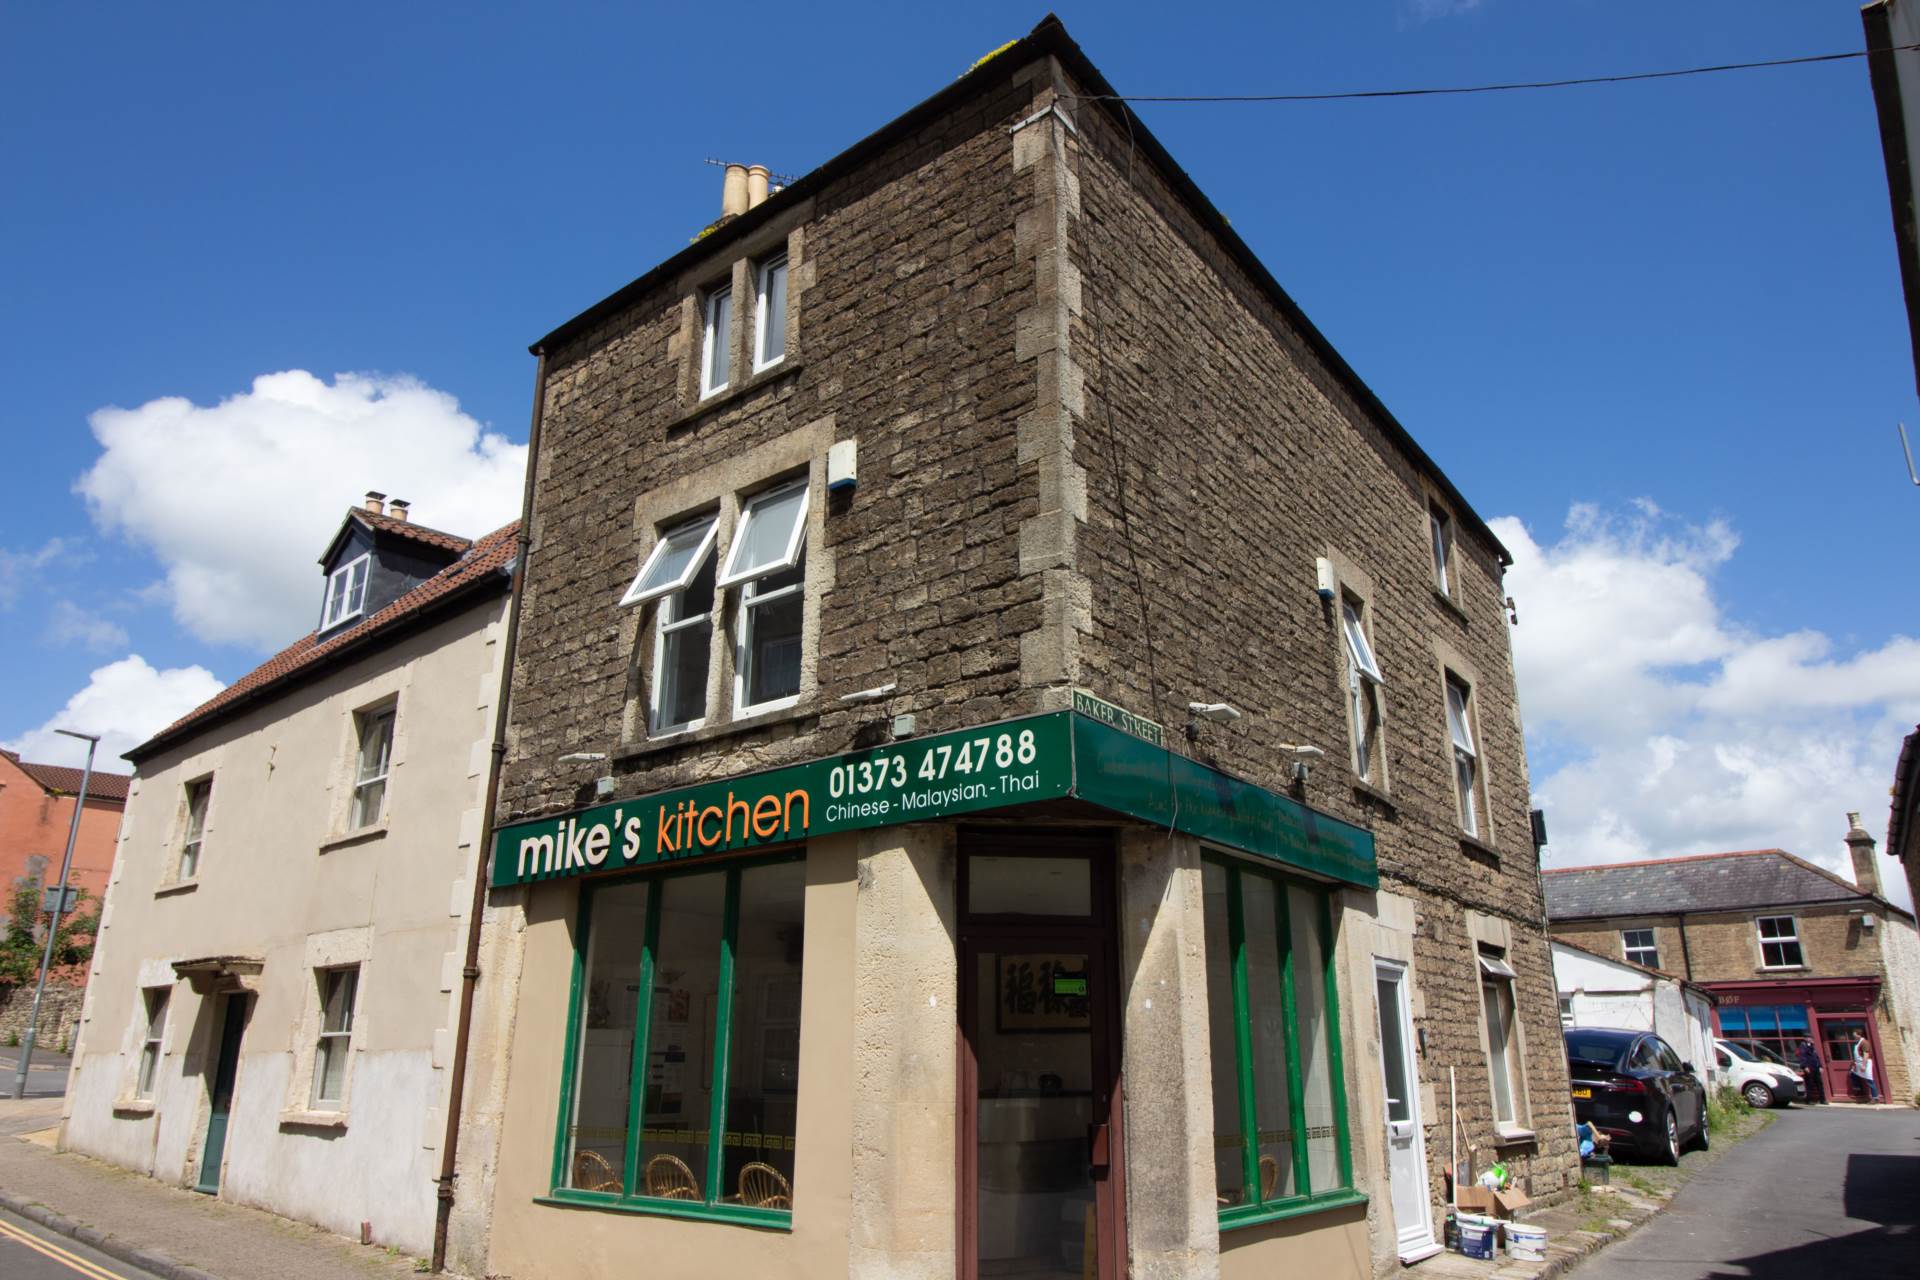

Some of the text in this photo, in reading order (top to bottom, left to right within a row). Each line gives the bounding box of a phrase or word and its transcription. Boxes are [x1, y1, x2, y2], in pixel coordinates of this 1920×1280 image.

[1076, 694, 1159, 743] BAKER STREET
[829, 729, 1037, 799] 01373 474788
[825, 799, 890, 823] Chinese
[901, 783, 986, 811] Malaysian
[1000, 770, 1040, 794] Thai
[517, 789, 809, 876] mike's kitchen
